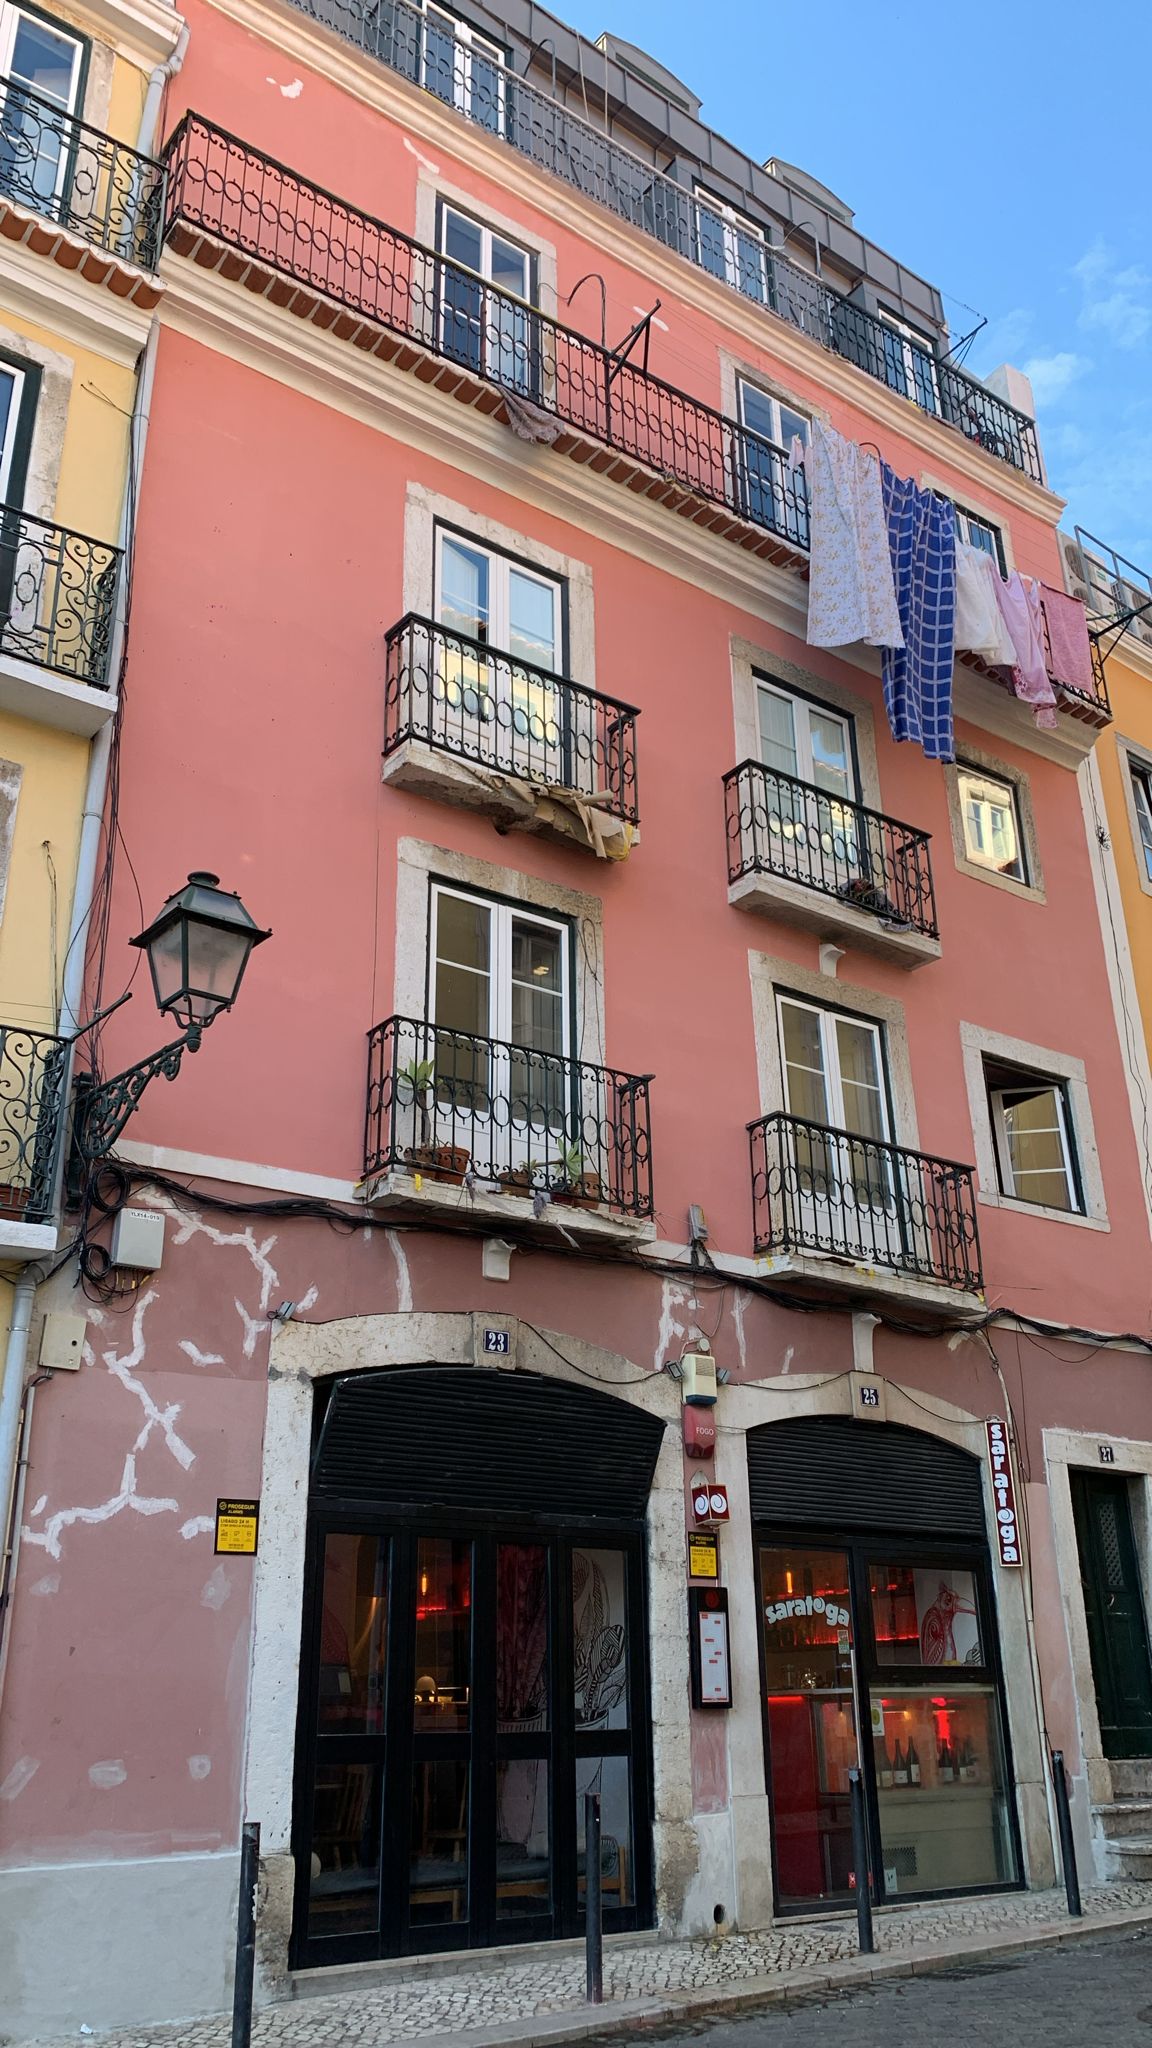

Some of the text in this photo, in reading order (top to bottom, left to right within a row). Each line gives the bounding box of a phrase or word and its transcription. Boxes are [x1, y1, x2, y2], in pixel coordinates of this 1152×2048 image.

[488, 1332, 505, 1352] 23
[863, 1388, 876, 1405] 25
[695, 1427, 714, 1436] FOGO
[1101, 1447, 1111, 1461] 27
[990, 1424, 1018, 1562] saratoga
[765, 1595, 850, 1627] saratoga
